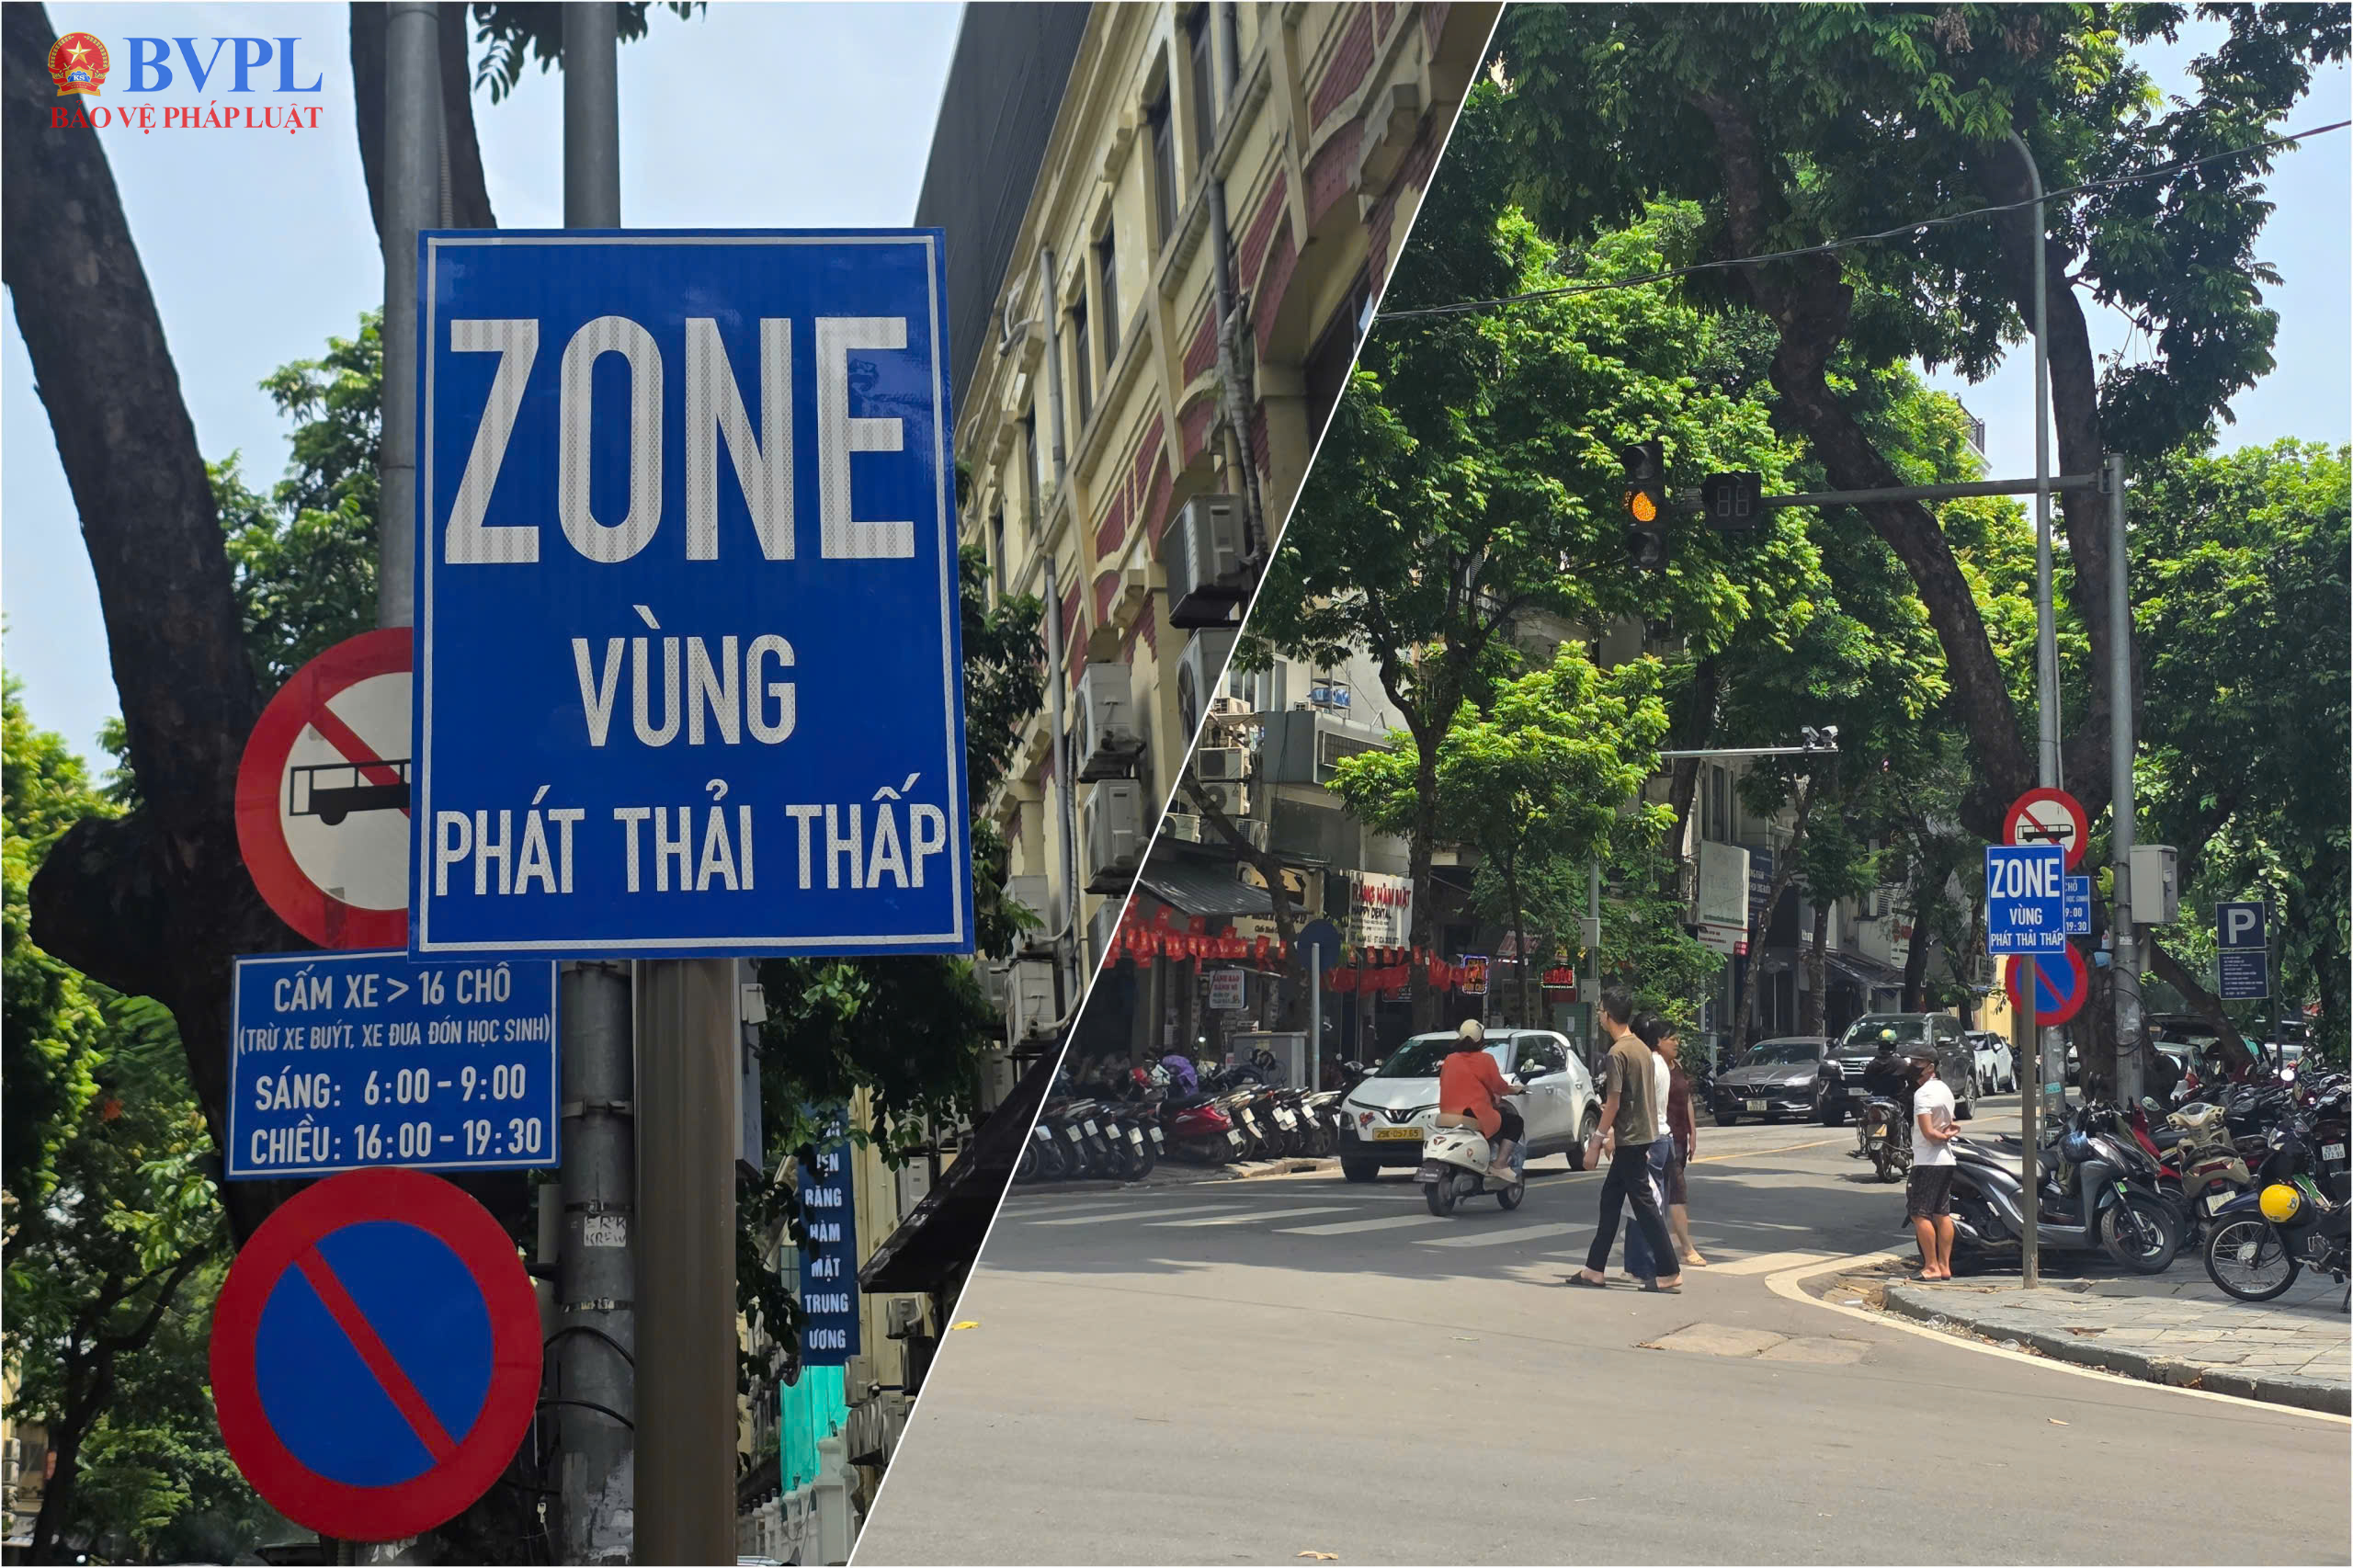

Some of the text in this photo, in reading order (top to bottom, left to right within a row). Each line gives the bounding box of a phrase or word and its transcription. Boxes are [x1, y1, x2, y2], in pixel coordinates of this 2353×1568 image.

[445, 315, 915, 564] ZONE
[572, 605, 796, 746] VÙNG
[436, 773, 946, 895] PHÁT THẢI THẤP
[1990, 858, 2060, 898] ZONE
[2009, 903, 2042, 926] VÙNG
[2066, 921, 2087, 931] 19:30
[2228, 909, 2256, 944] P
[1991, 927, 2063, 947] PHÁT THẢI THẤP
[274, 964, 333, 1012] CẤM
[344, 973, 380, 1008] XE
[418, 971, 445, 1006] 16
[239, 1014, 551, 1055] (TRỪ XE BUÝT, XE ĐƯA ĐÓN HỌC SINH)
[255, 1065, 341, 1111] SÁNG:
[250, 1113, 341, 1165] CHIỀU:
[805, 1185, 842, 1207] RĂNG
[810, 1221, 840, 1242] HÀM
[812, 1254, 840, 1282] MẶT
[804, 1294, 849, 1313] TRUNG
[809, 1329, 847, 1350] ƯƠNG
